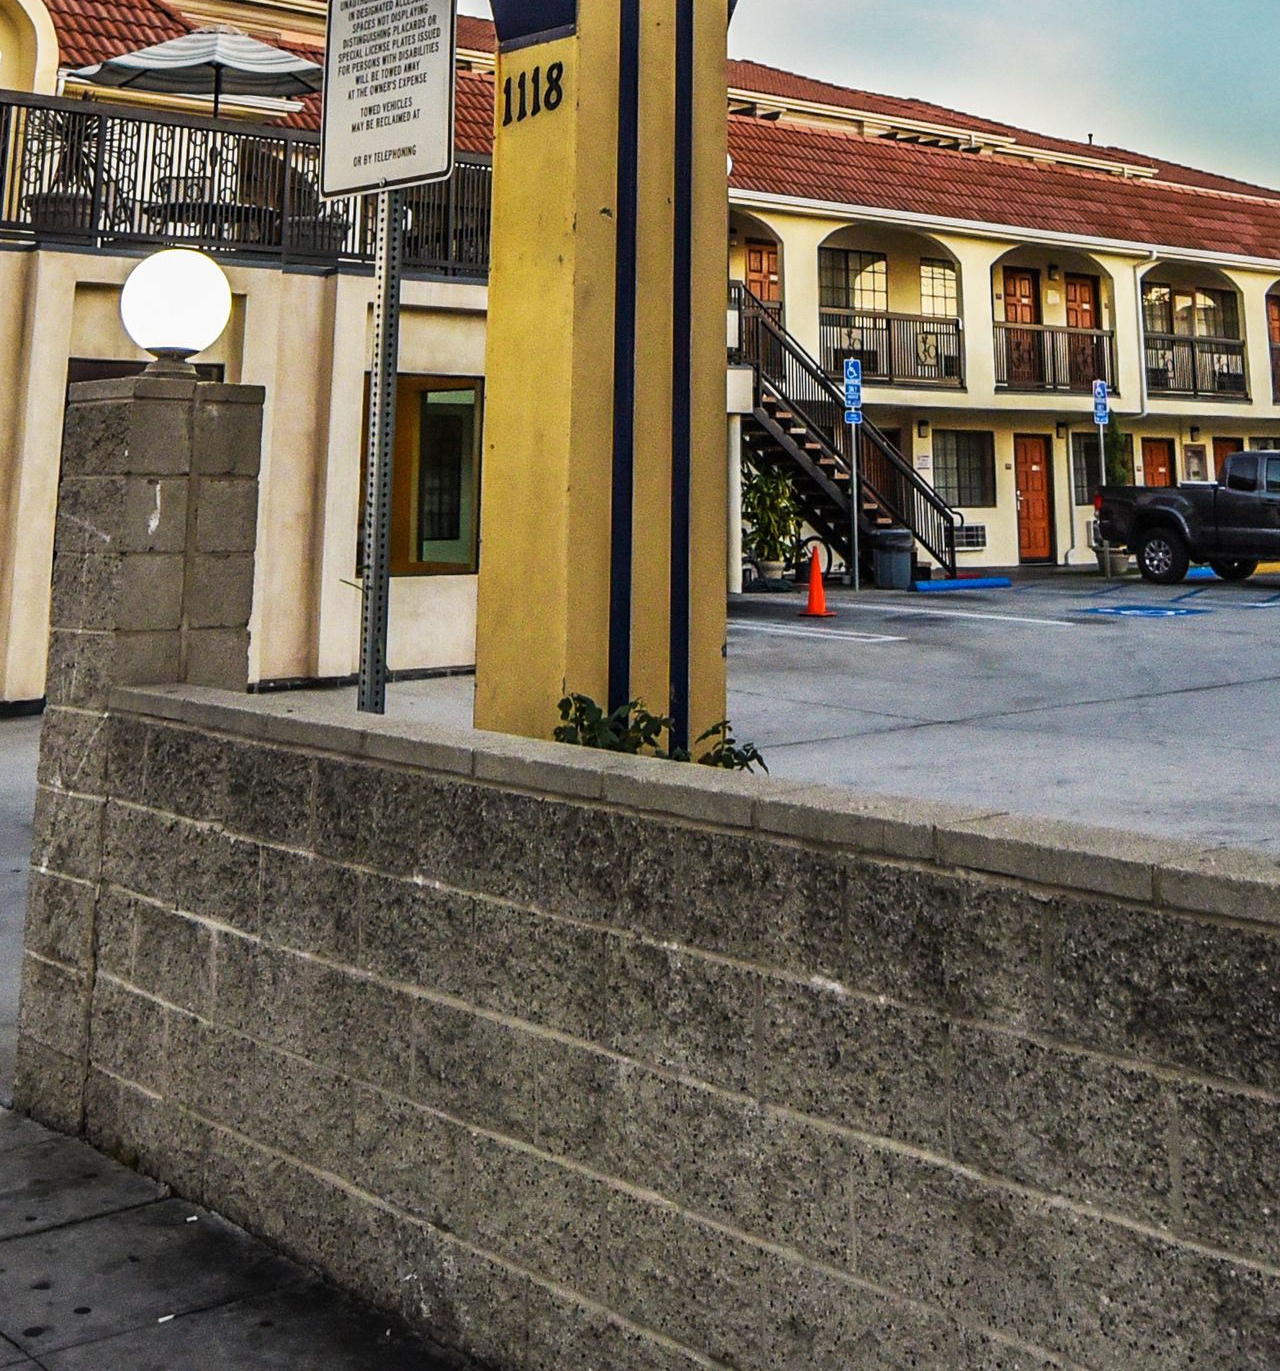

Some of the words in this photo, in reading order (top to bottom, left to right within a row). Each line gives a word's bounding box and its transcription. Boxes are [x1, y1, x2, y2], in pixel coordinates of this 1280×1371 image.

[348, 10, 355, 21] IN
[356, 0, 394, 19] DESIGNATED
[352, 18, 376, 33] SPACES
[377, 14, 389, 26] NOT
[391, 3, 429, 23] DISPLAYING
[338, 49, 363, 63] SPECIAL
[364, 40, 390, 56] LICENSE
[392, 34, 416, 48] PLATES
[417, 27, 441, 43] ISSUED
[343, 28, 391, 49] DISTINGUISHING
[392, 17, 426, 36] PLACARDS
[427, 14, 437, 27] OR
[338, 64, 350, 76] FOR
[352, 57, 380, 73] PERSONS
[382, 53, 397, 65] WITH
[398, 41, 439, 61] DISABILITIES
[355, 73, 369, 85] WILL
[371, 70, 379, 82] BE
[381, 65, 402, 79] TOWED
[403, 59, 421, 73] AWAY
[348, 89, 355, 100] AT
[357, 86, 368, 98] THE
[370, 79, 397, 95] OWNER'S
[398, 72, 427, 89] EXPENSE
[503, 61, 563, 127] 1118
[351, 122, 364, 133] MAY
[366, 119, 374, 130] BE
[376, 112, 411, 128] RECLAIMED
[413, 108, 421, 119] AT
[360, 104, 380, 118] TOWED
[382, 96, 413, 113] VEHICLES
[353, 155, 362, 167] OR
[363, 153, 372, 165] BY
[374, 144, 417, 163] TELEPHONING
